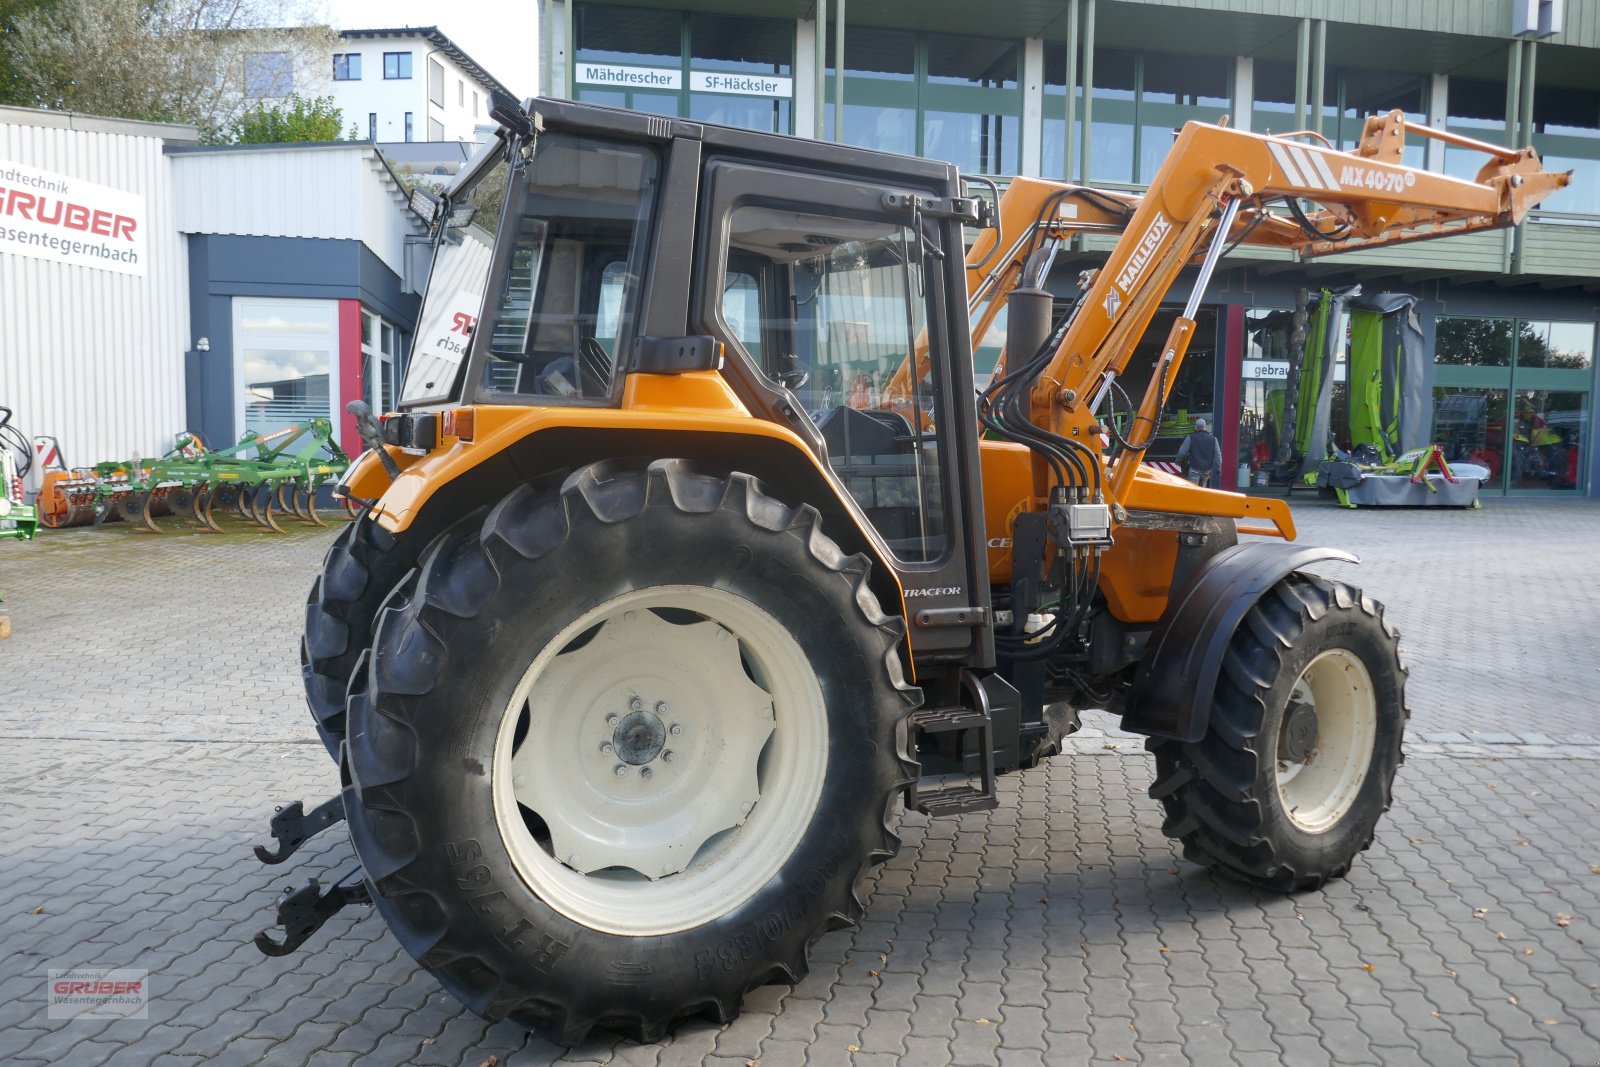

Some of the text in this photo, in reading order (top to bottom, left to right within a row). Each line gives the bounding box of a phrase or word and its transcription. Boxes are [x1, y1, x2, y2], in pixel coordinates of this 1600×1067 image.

[586, 68, 673, 85] Mähdrescher
[705, 76, 778, 93] SF-Häcksler
[0, 168, 69, 195] ndtechnik
[1340, 165, 1364, 187] MX
[0, 186, 138, 242] RUBER
[1118, 215, 1169, 292] MAILLEUX
[987, 537, 1013, 548] CE
[903, 586, 961, 598] TRACFOR
